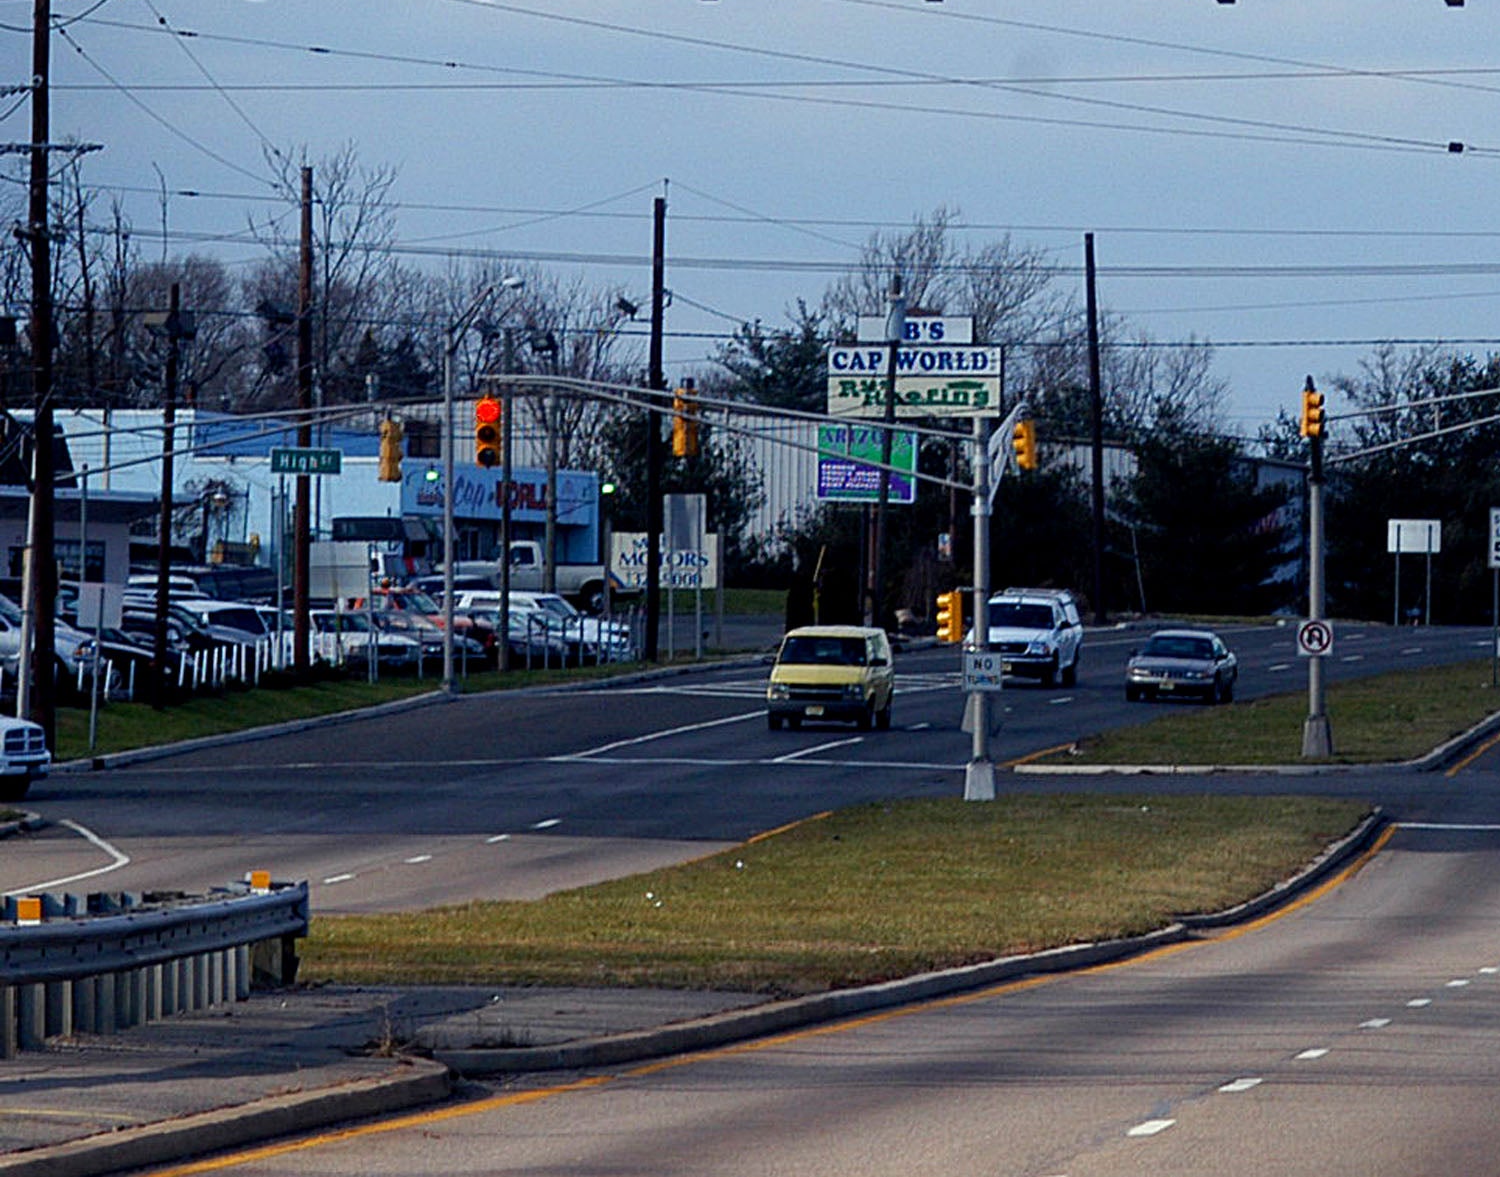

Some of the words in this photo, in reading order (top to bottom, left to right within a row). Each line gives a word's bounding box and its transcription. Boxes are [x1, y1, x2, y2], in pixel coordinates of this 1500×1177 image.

[832, 350, 883, 372] CAP
[895, 350, 989, 373] WORLD
[973, 658, 993, 671] NO
